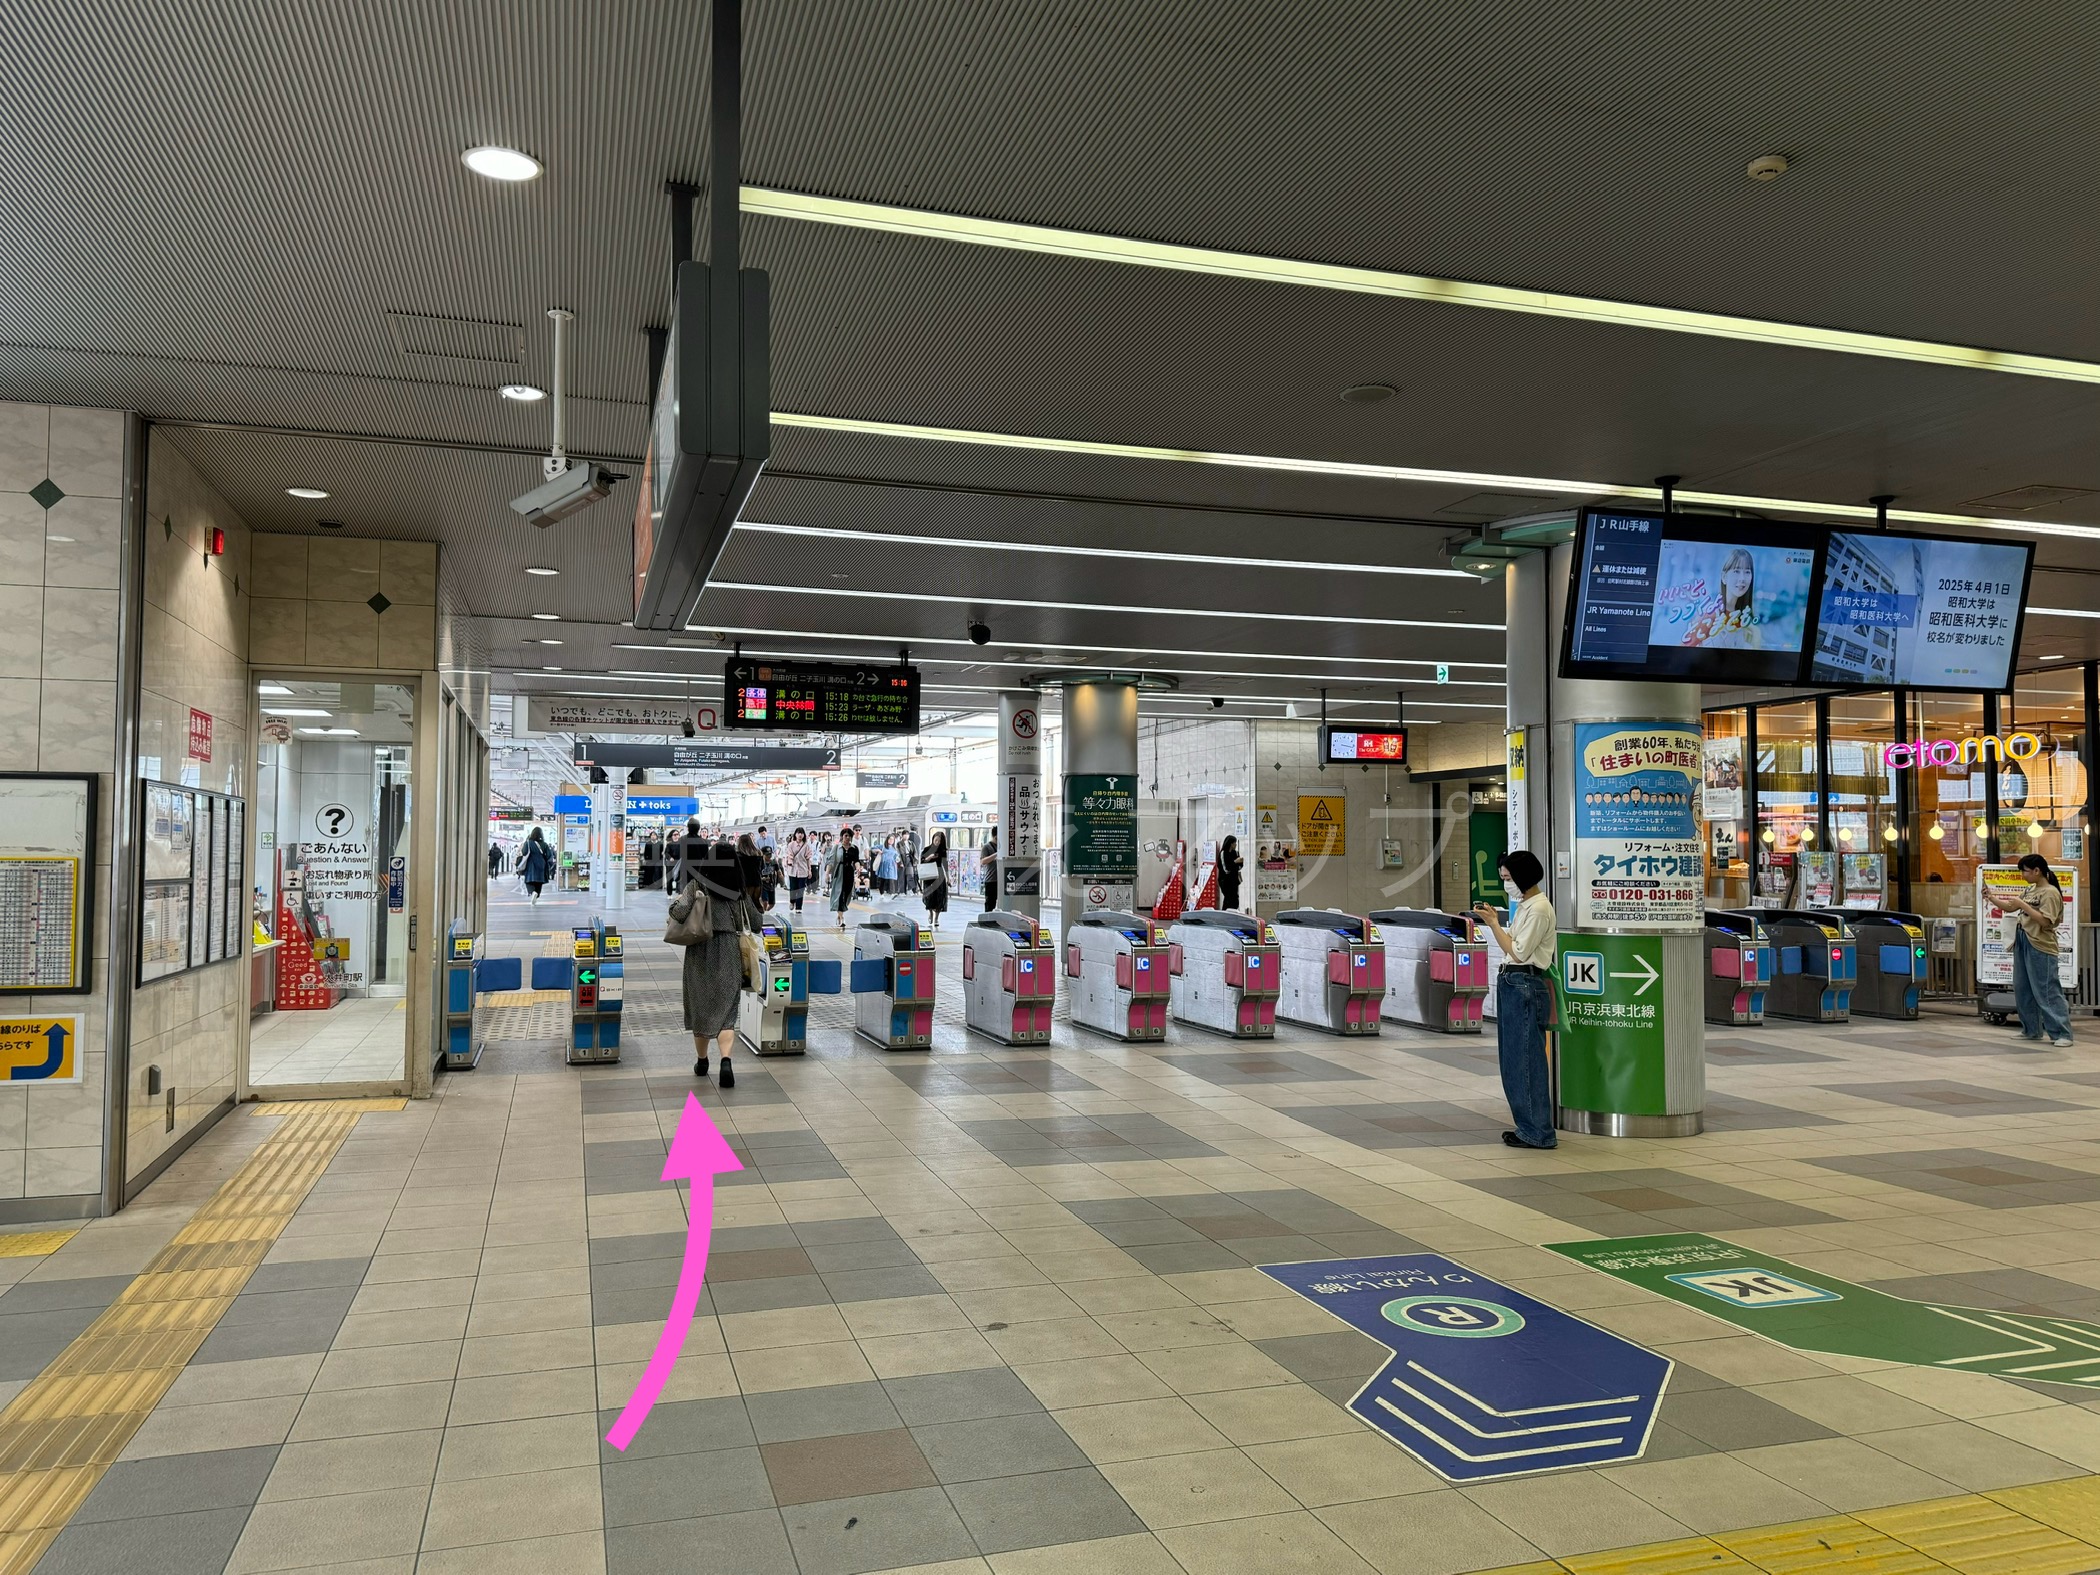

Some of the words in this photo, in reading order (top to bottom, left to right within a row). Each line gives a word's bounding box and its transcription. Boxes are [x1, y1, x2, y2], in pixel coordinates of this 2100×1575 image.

[1600, 519, 1650, 533] JR山手線
[1938, 578, 2010, 595] 2025年4月1日
[1834, 596, 1878, 608] 昭和大学は
[1948, 596, 1996, 609] 昭和大学は
[1587, 606, 1598, 614] JR
[1599, 606, 1635, 616] Yamanote
[1637, 608, 1651, 616] Line
[1850, 609, 1909, 622] 昭和医科大学へ
[1929, 611, 2008, 629] 昭和医科大学に
[1927, 631, 2005, 646] 校名が変わりました
[750, 667, 755, 680] 1
[772, 674, 798, 682] 自由が丘
[800, 675, 825, 684] 二子玉川
[856, 672, 865, 685] 2
[738, 688, 745, 697] 2
[825, 692, 849, 701] 15:18
[746, 699, 767, 709] 急行
[775, 701, 815, 710] 中央林間
[825, 702, 849, 711] 15:23
[551, 706, 682, 719] いつでも、どこでも、おトクに、
[738, 710, 745, 718] 2
[825, 713, 848, 722] 15:26
[581, 745, 587, 760] 1
[826, 750, 836, 764] 2
[1884, 732, 2041, 769] etomo
[899, 775, 906, 785] 2
[649, 801, 671, 809] toks
[1083, 797, 1134, 811] 等々力眼科
[1716, 827, 1734, 844] えん
[300, 843, 367, 854] ごあんない
[1625, 842, 1700, 853] リフォーム・注文住宅
[2063, 839, 2082, 848] Uber
[297, 856, 332, 864] Question
[305, 870, 372, 880] お忘れ物承り所
[305, 891, 381, 900] 車いすご利用の方
[1609, 889, 1693, 900] 0120-031-866
[1247, 956, 1260, 968] IC
[1354, 954, 1366, 967] IC
[1458, 953, 1470, 966] IC
[1745, 951, 1755, 961] IC
[1020, 959, 1033, 973] IC
[1137, 957, 1149, 970] IC
[1570, 963, 1597, 983] JK
[1567, 1002, 1655, 1018] JR京浜東北線
[0, 1024, 41, 1034] 線のりば
[1636, 1019, 1653, 1028] Line
[1366, 1268, 1426, 1280] Rinkai
[1308, 1273, 1473, 1295] りんかい線
[1701, 1275, 1795, 1298] JK
[1419, 1305, 1485, 1326] R
